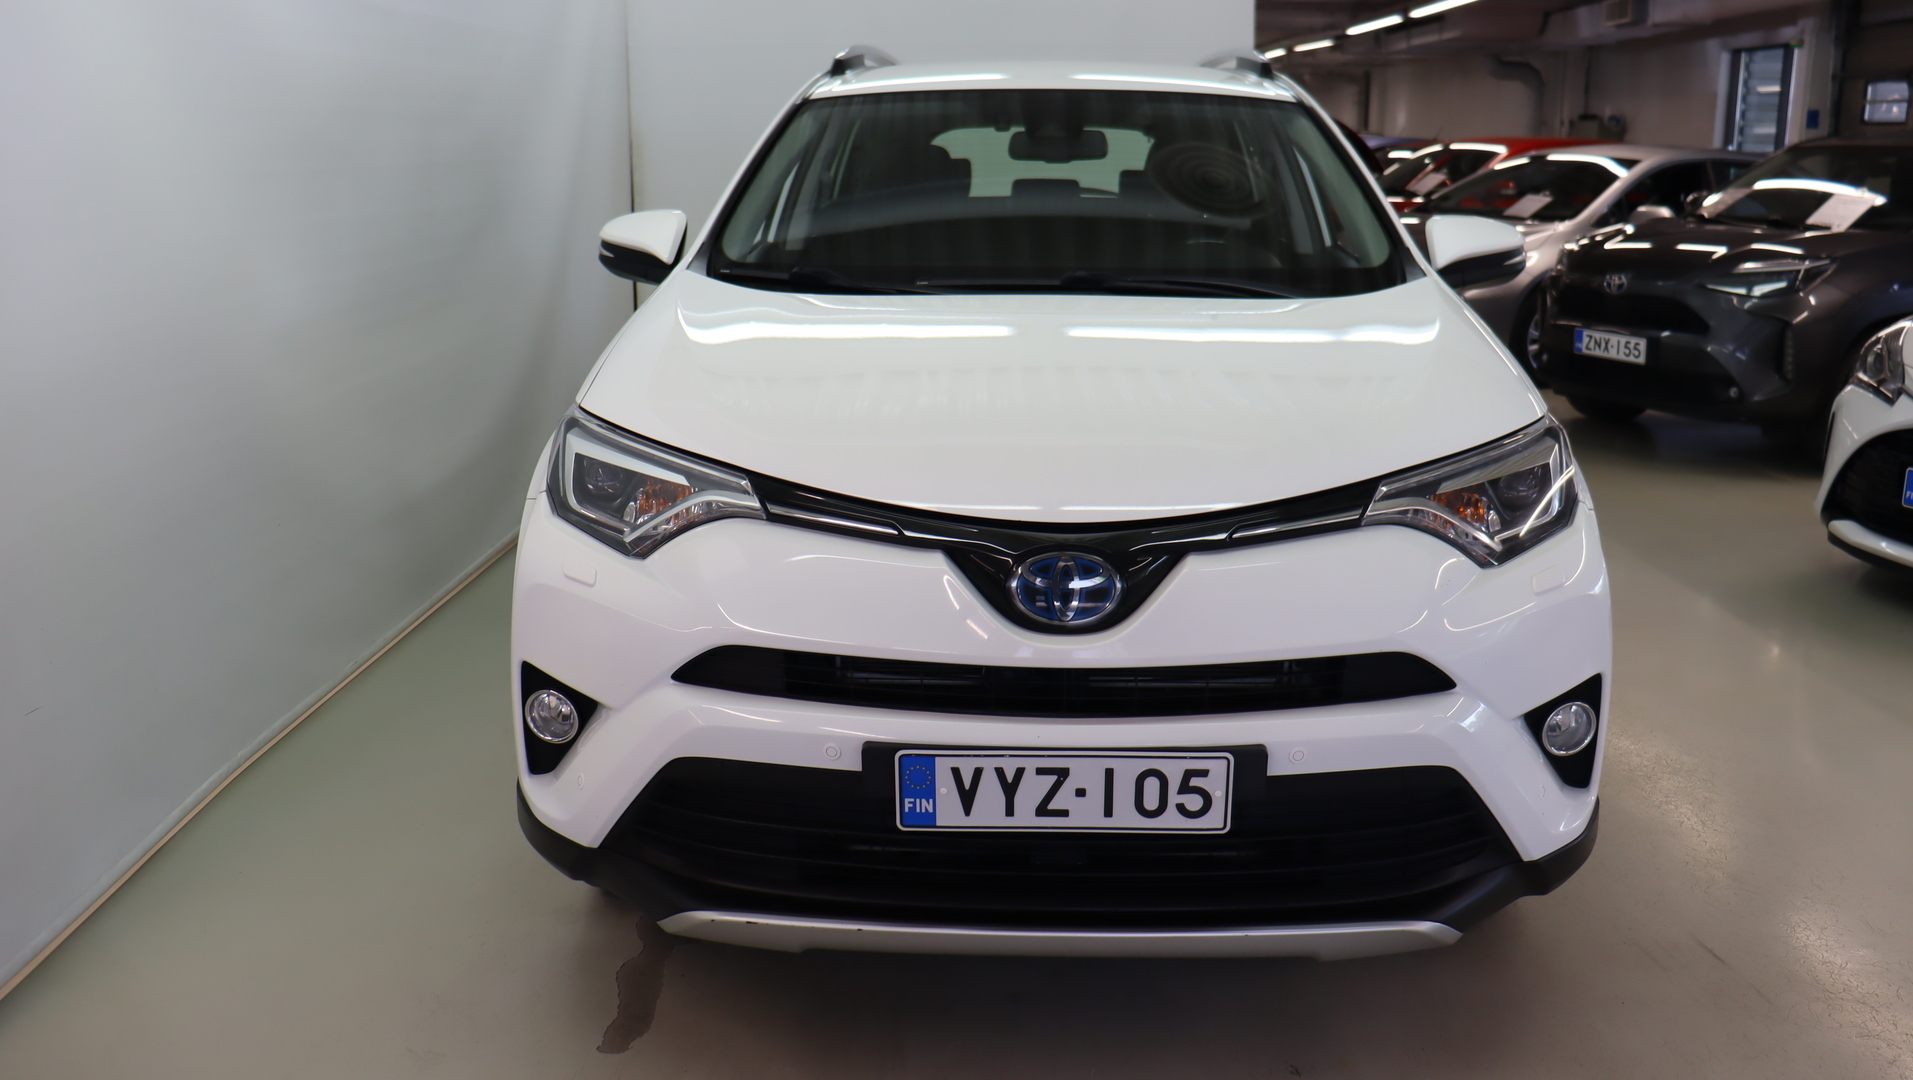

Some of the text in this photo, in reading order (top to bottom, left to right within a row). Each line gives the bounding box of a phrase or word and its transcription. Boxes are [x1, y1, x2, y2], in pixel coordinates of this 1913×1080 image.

[1585, 334, 1641, 359] ZNX-155
[950, 766, 1213, 819] VYZ-105
[904, 798, 934, 813] FIN
